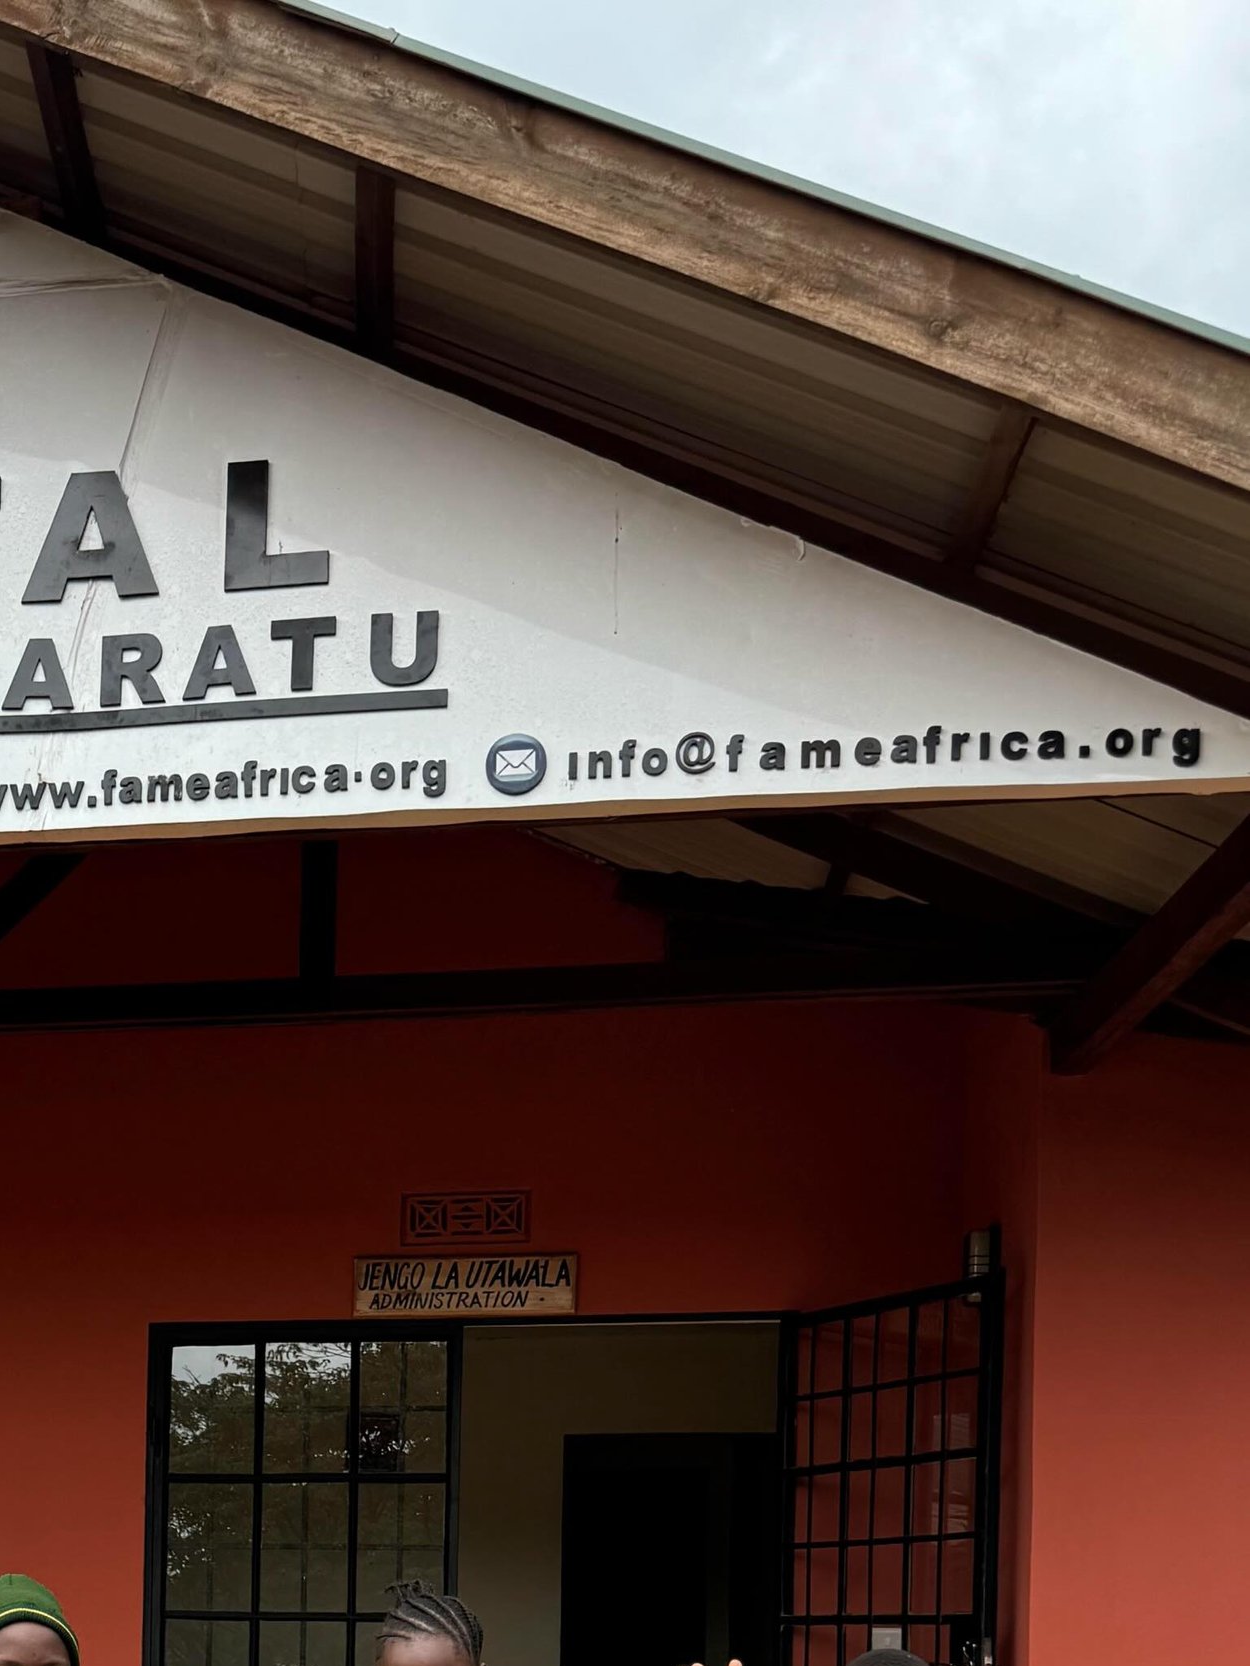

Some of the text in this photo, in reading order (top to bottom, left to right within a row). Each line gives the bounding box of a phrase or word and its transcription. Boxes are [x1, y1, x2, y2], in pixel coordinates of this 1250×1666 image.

[567, 721, 1202, 780] info@fameafrica.org
[358, 1258, 571, 1291] JENGO LA UTAWALA
[369, 1290, 529, 1310] ADMINISTRATION
